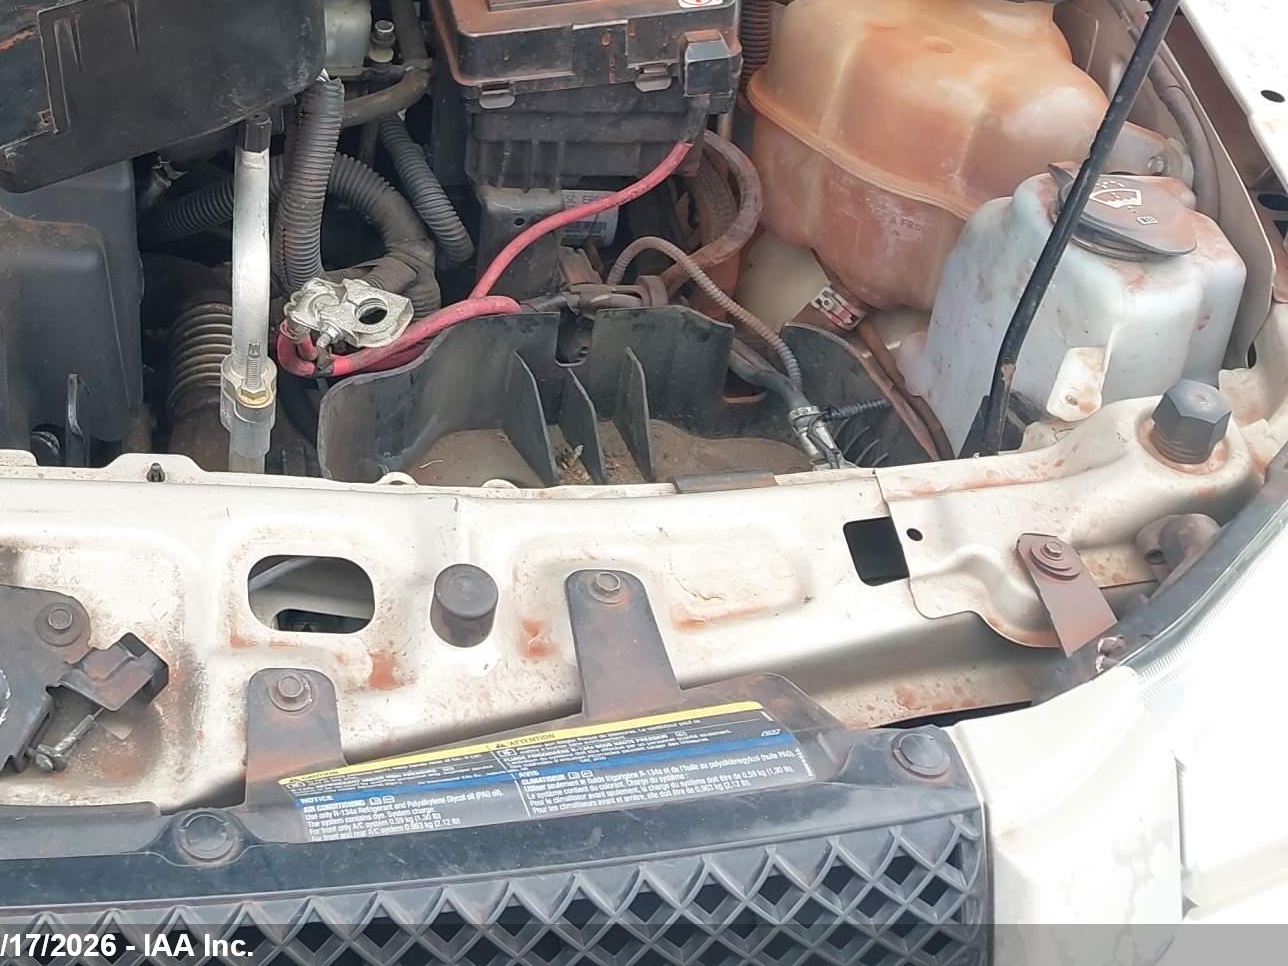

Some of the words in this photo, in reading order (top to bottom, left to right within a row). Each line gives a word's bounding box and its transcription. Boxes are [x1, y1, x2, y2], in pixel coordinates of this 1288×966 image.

[300, 795, 335, 804] NOTICE
[308, 820, 320, 828] The
[322, 817, 344, 827] system
[387, 809, 411, 819] System
[366, 818, 388, 828] system
